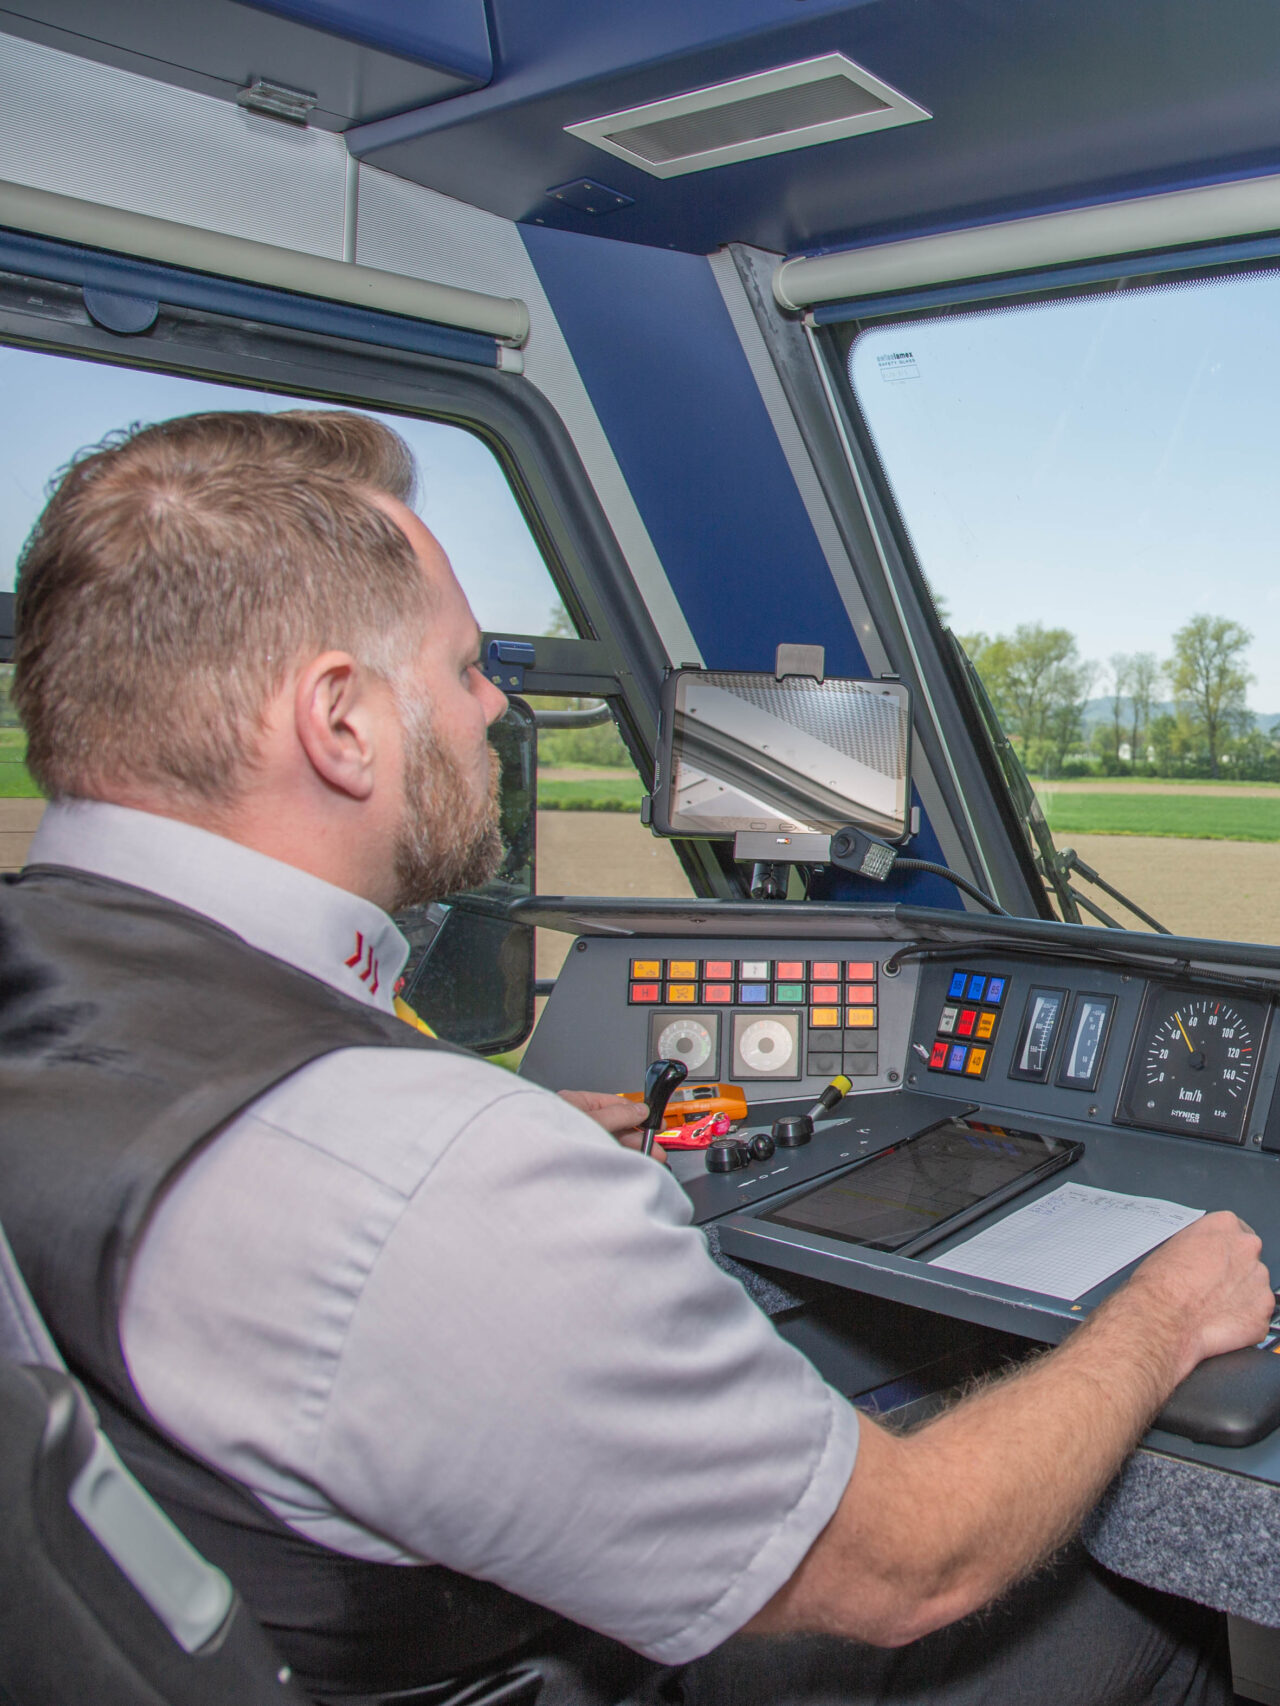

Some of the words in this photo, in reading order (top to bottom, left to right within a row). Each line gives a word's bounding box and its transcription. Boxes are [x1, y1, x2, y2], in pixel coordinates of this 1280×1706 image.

[1188, 1017, 1198, 1027] 60
[1208, 1016, 1218, 1026] 80
[1171, 1030, 1181, 1040] 40
[1222, 1028, 1234, 1039] 100
[1159, 1049, 1169, 1059] 20
[1227, 1048, 1240, 1059] 120
[1159, 1072, 1165, 1082] 0
[1223, 1069, 1236, 1080] 140
[1179, 1087, 1202, 1103] km/h
